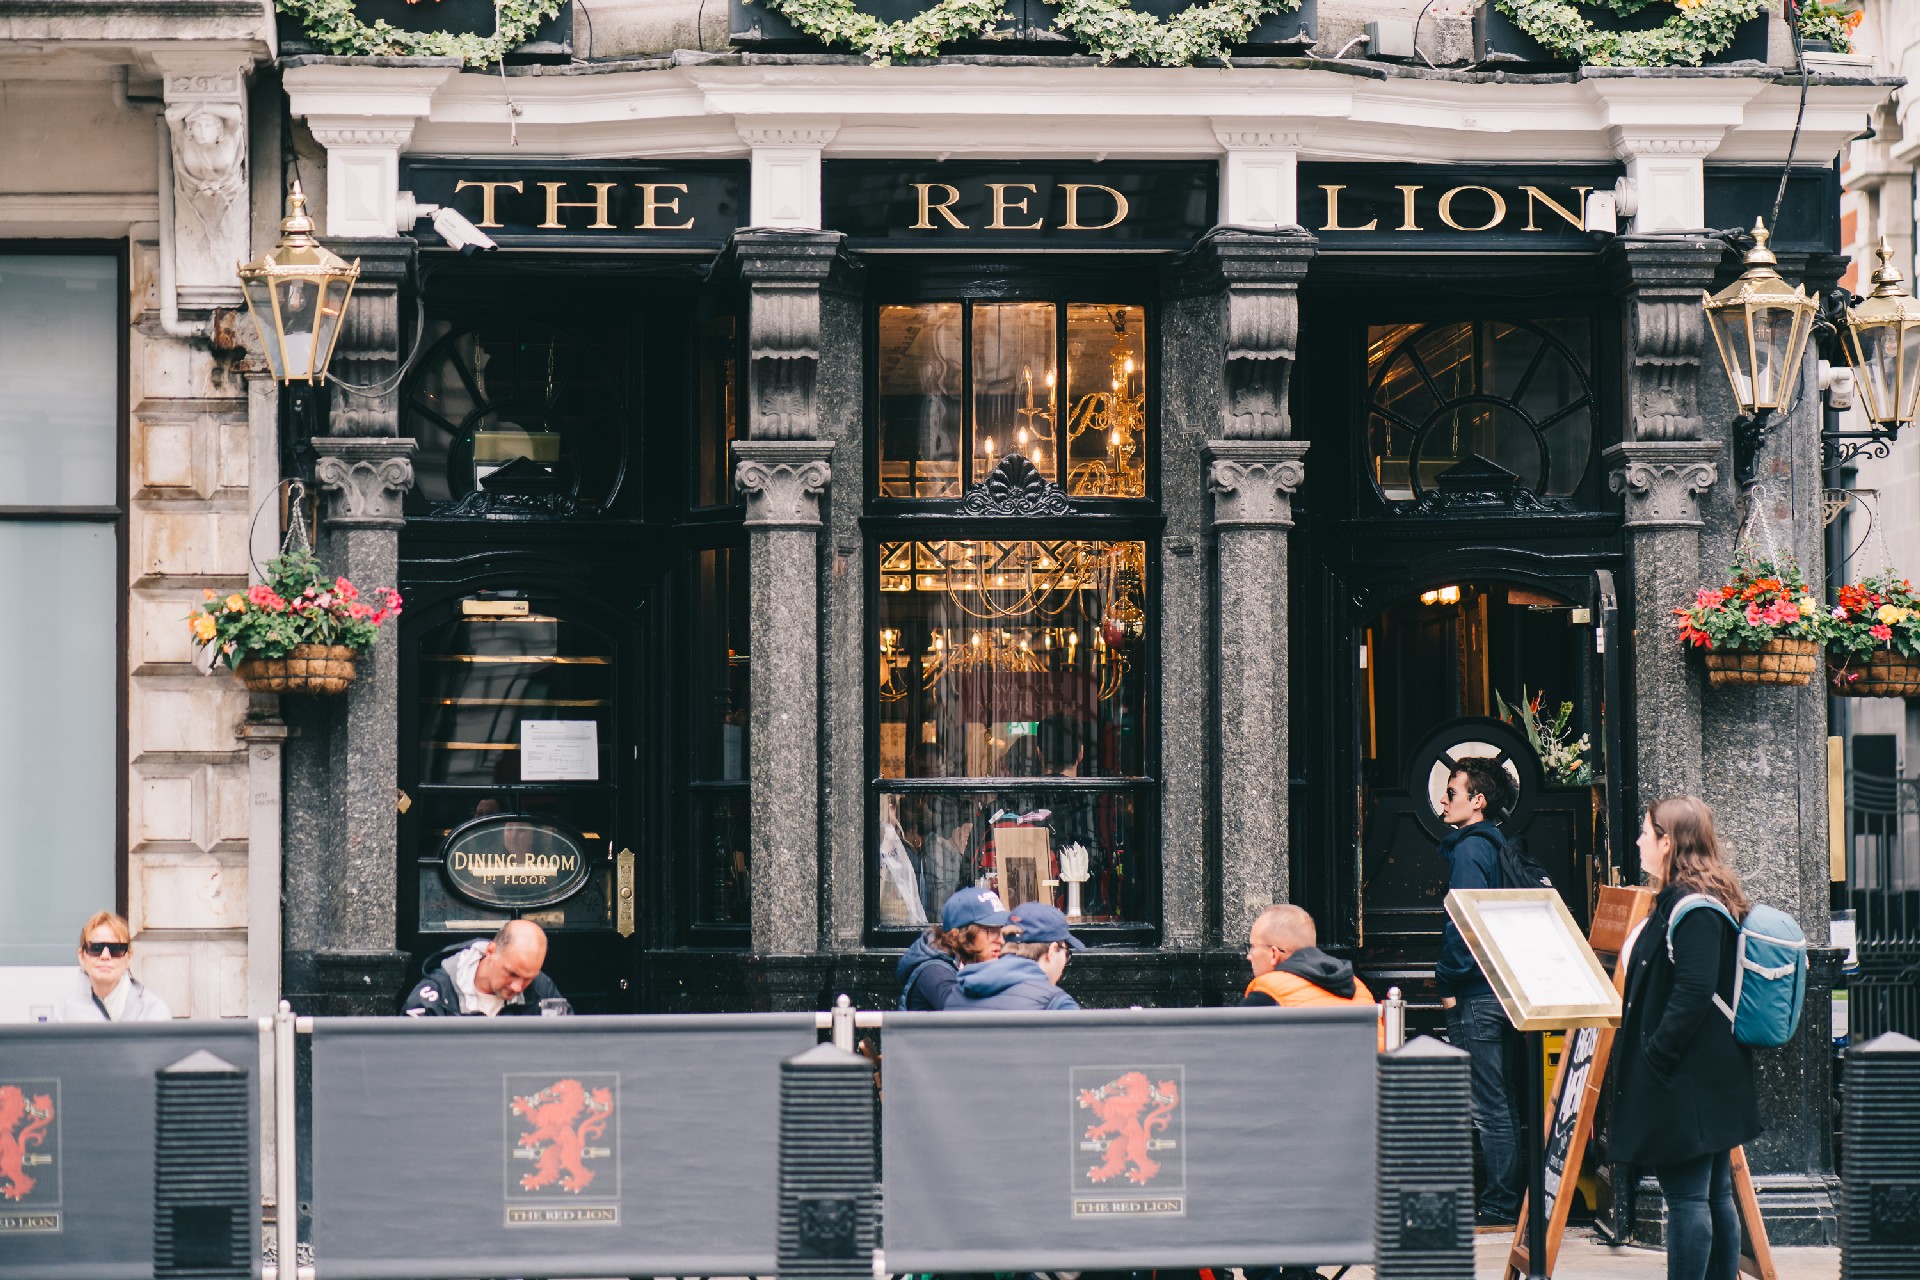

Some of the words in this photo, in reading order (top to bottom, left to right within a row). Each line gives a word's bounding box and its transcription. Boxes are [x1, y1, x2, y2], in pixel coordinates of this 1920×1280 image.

[456, 180, 695, 229] THE
[909, 183, 1129, 230] RED
[1318, 184, 1593, 232] LION
[454, 851, 517, 871] DINING
[525, 852, 576, 871] ROOM
[504, 875, 547, 885] FLOOR
[1079, 1202, 1109, 1212] THE
[1112, 1202, 1140, 1212] RED
[1143, 1201, 1179, 1211] LION
[511, 1210, 543, 1221] THE
[545, 1210, 575, 1220] RED
[577, 1210, 613, 1220] LION
[19, 1217, 54, 1228] LION
